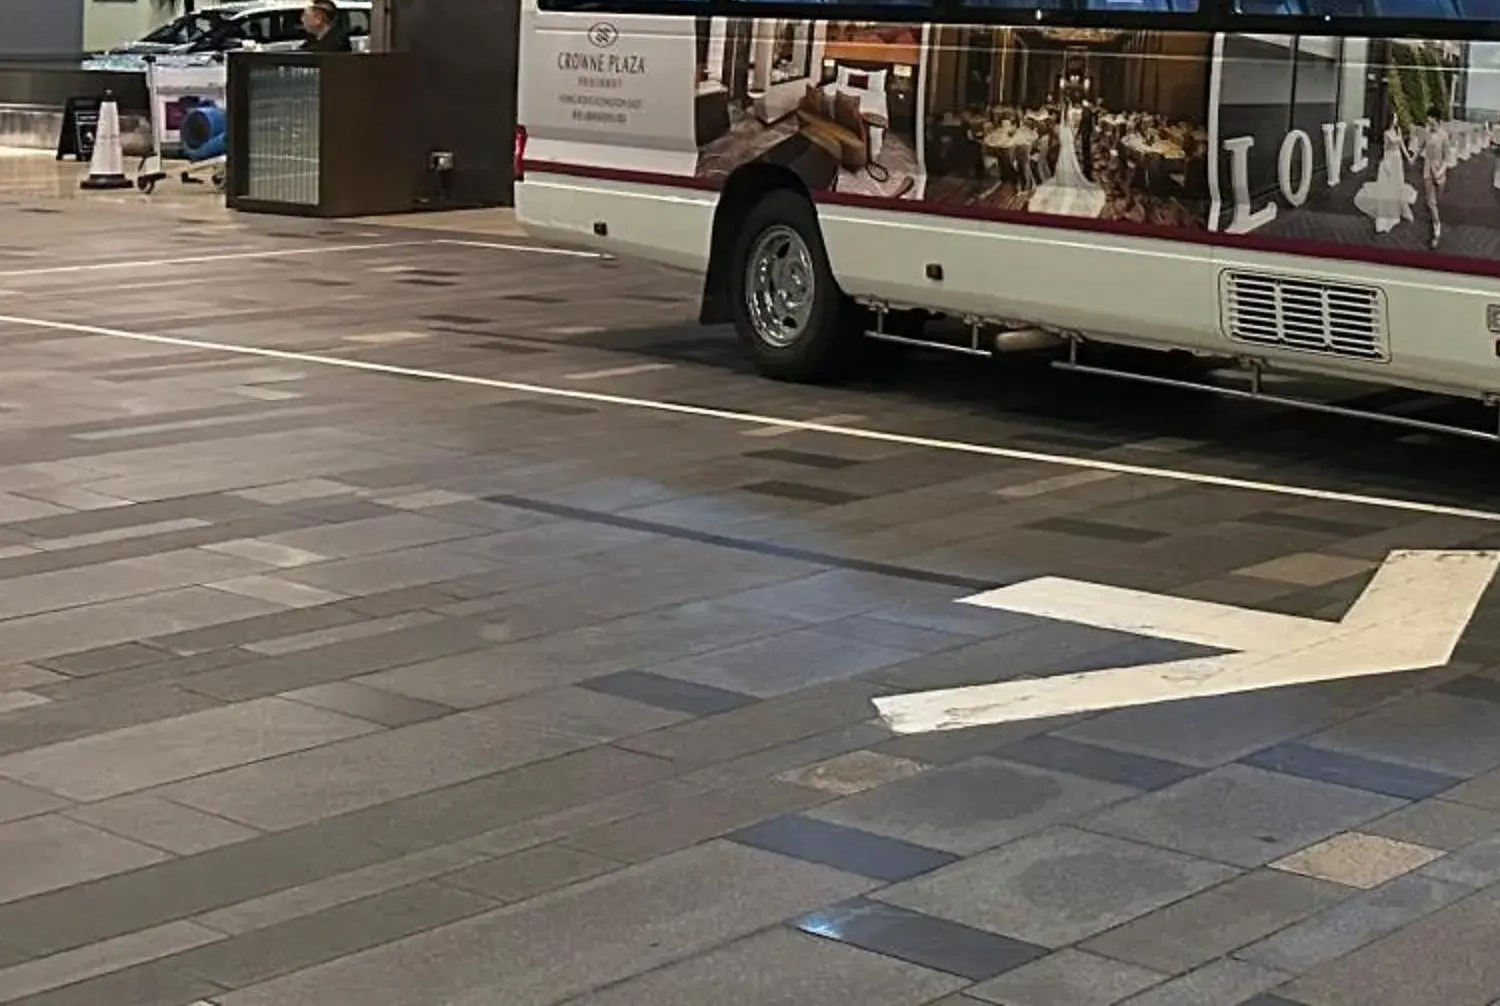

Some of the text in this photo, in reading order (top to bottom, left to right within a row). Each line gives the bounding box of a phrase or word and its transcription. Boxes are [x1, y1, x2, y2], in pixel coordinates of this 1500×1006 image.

[558, 52, 645, 74] CROWNE PLAZA
[1223, 118, 1370, 234] LOVE
